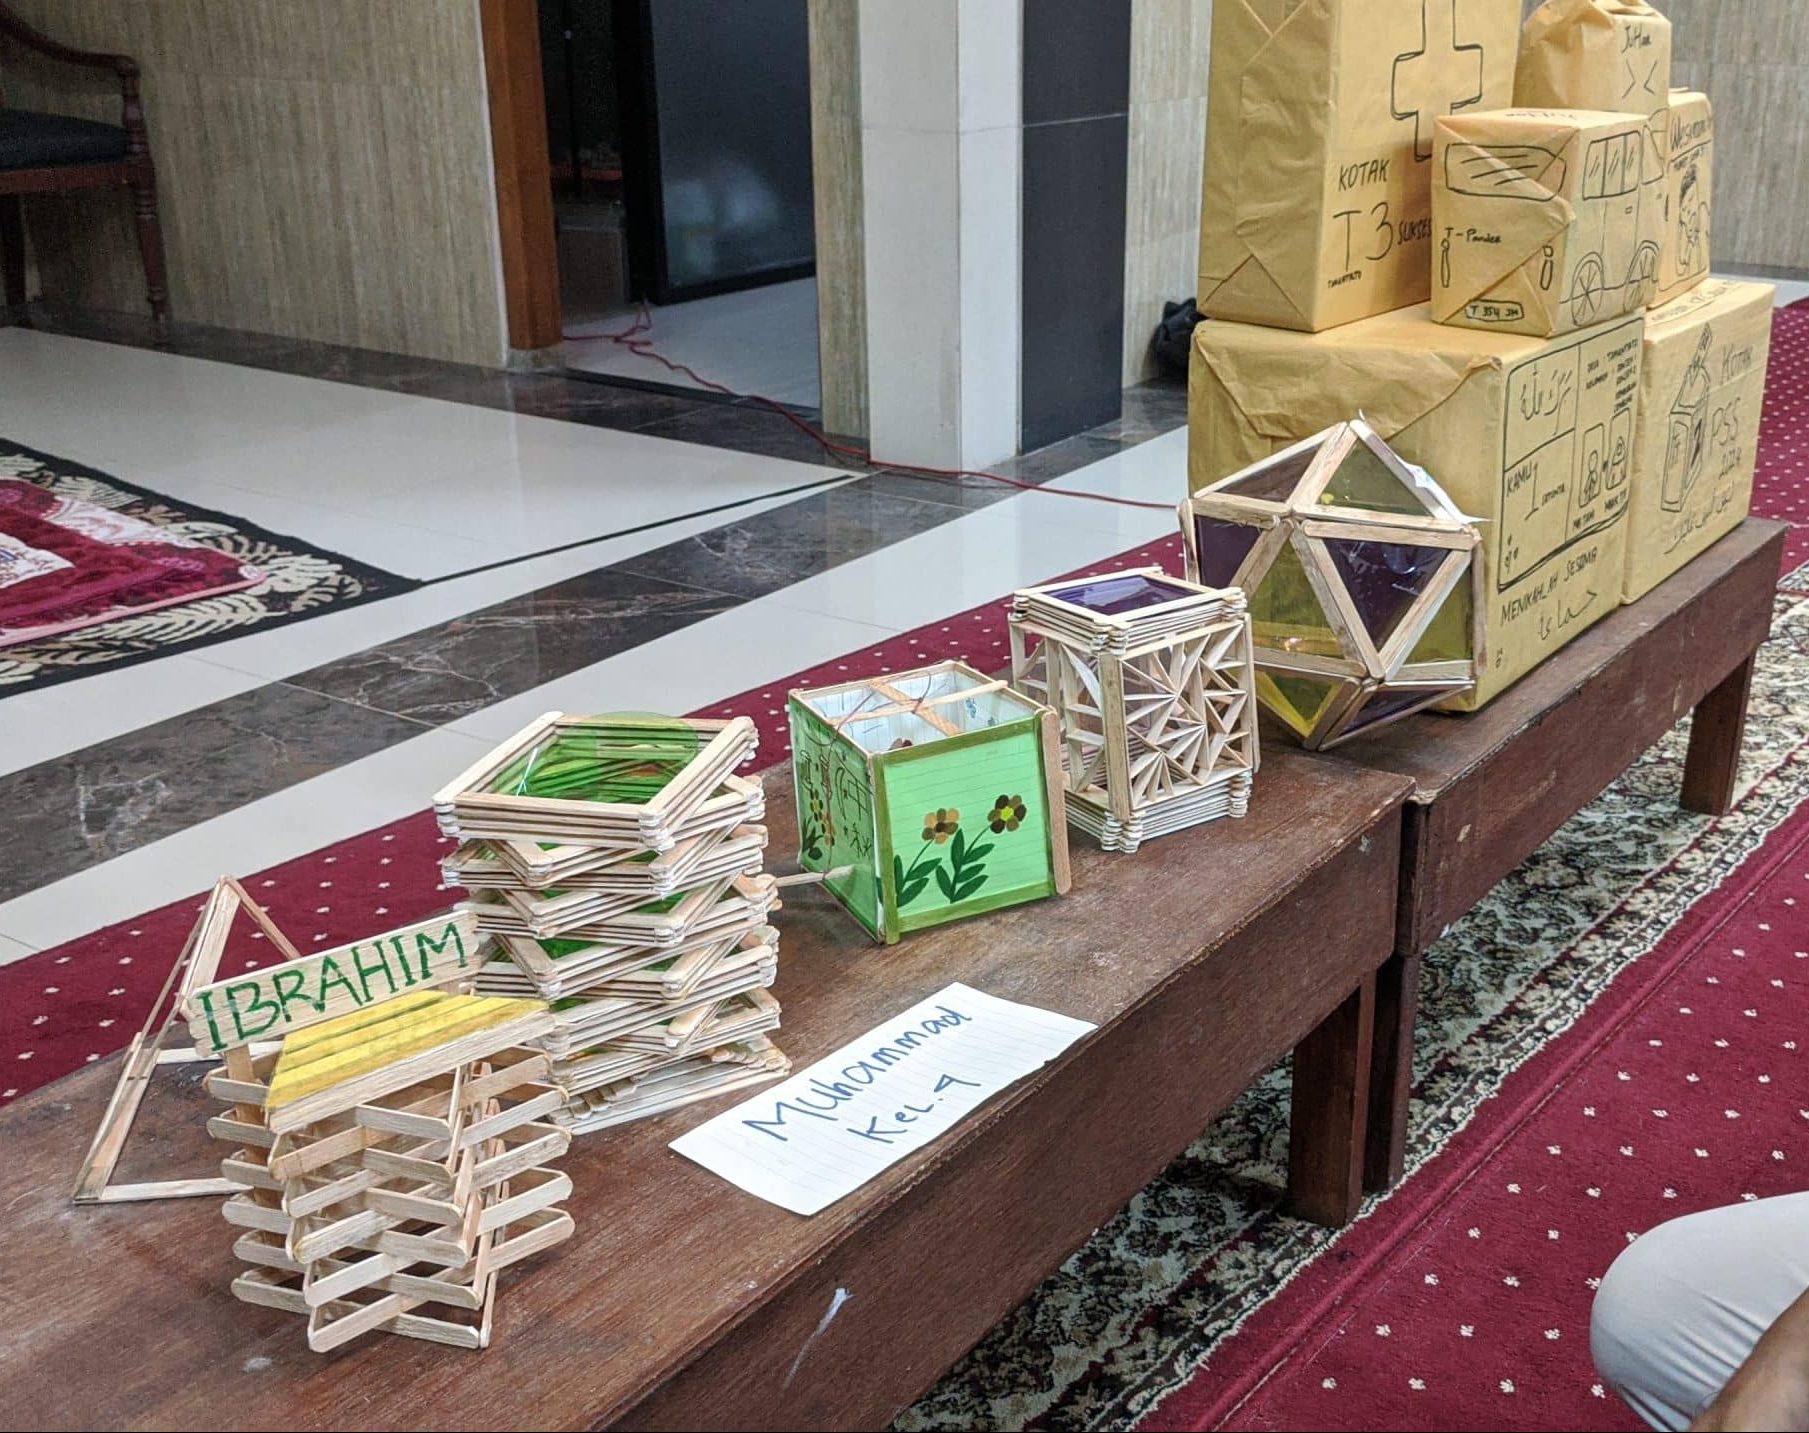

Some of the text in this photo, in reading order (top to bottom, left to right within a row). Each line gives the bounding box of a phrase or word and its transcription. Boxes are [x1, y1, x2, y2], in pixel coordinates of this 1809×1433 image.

[1338, 159, 1390, 192] KOTAK
[1505, 459, 1533, 498] KAMU
[195, 921, 469, 1053] IBRAHIM
[742, 1005, 974, 1142] Muhammad
